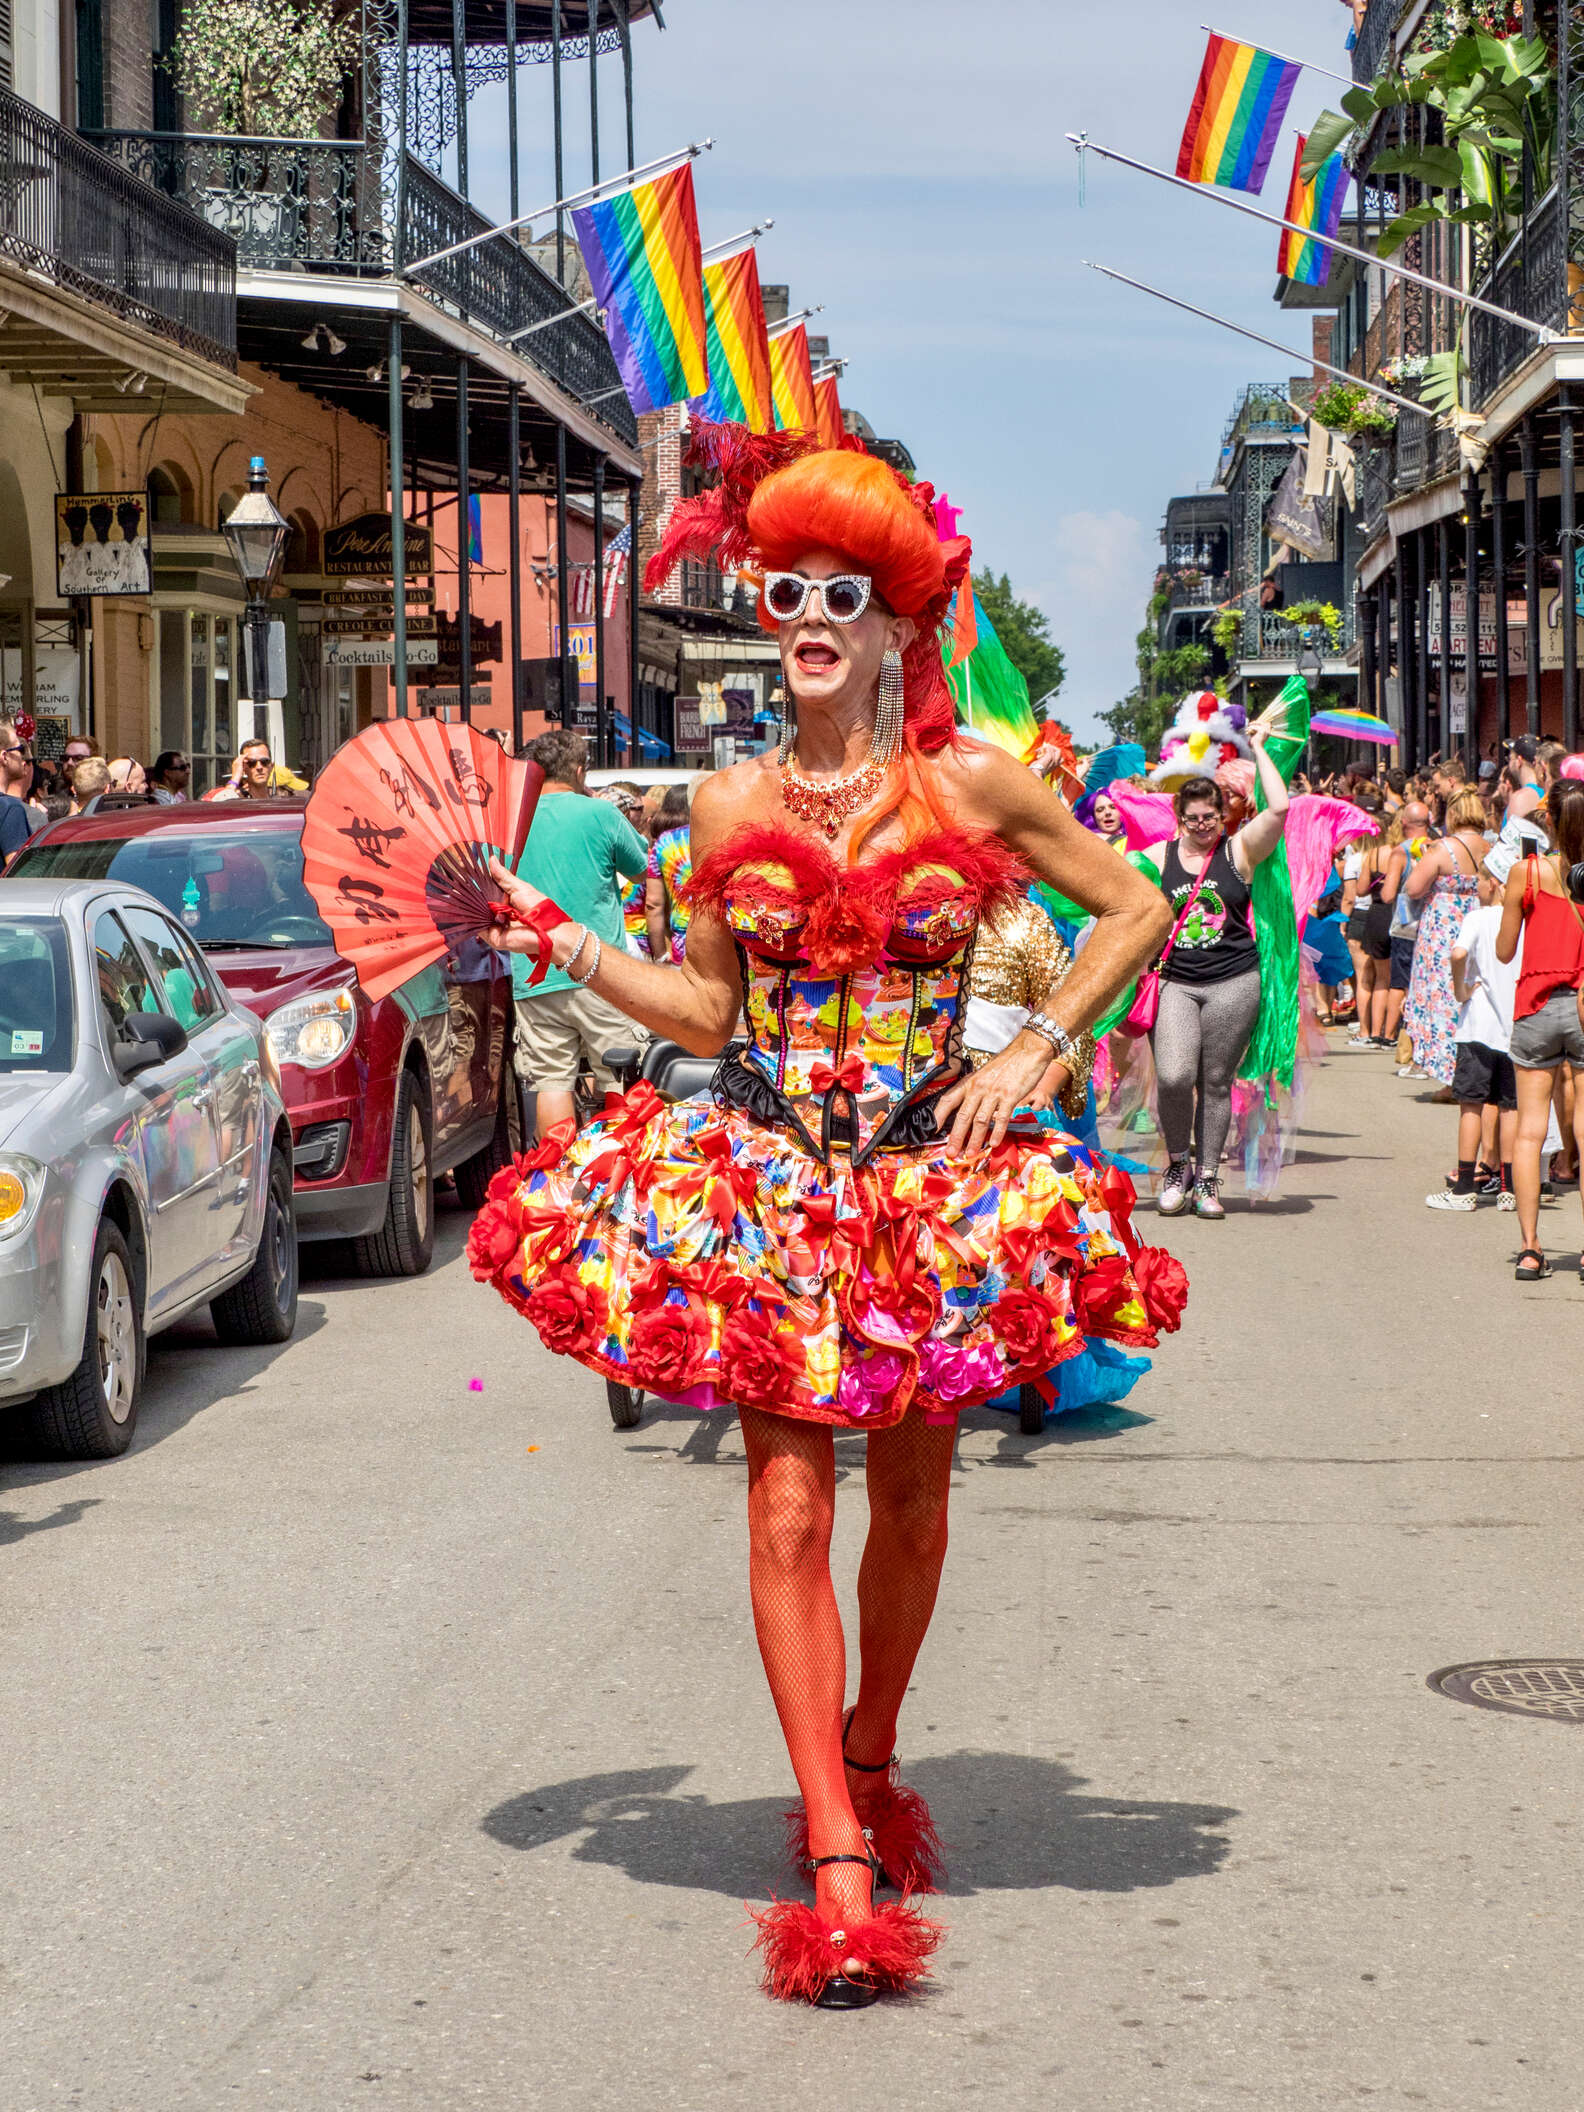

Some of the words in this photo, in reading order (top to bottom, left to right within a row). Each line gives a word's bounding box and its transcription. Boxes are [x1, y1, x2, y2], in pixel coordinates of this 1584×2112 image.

[409, 561, 429, 571] BAR
[86, 567, 120, 580] Gallery
[64, 584, 109, 594] Southern
[120, 581, 140, 591] Art
[409, 592, 427, 601] DAY
[328, 621, 374, 632] CREOLE
[327, 650, 393, 664] Cocktails
[405, 649, 436, 663] o-Go
